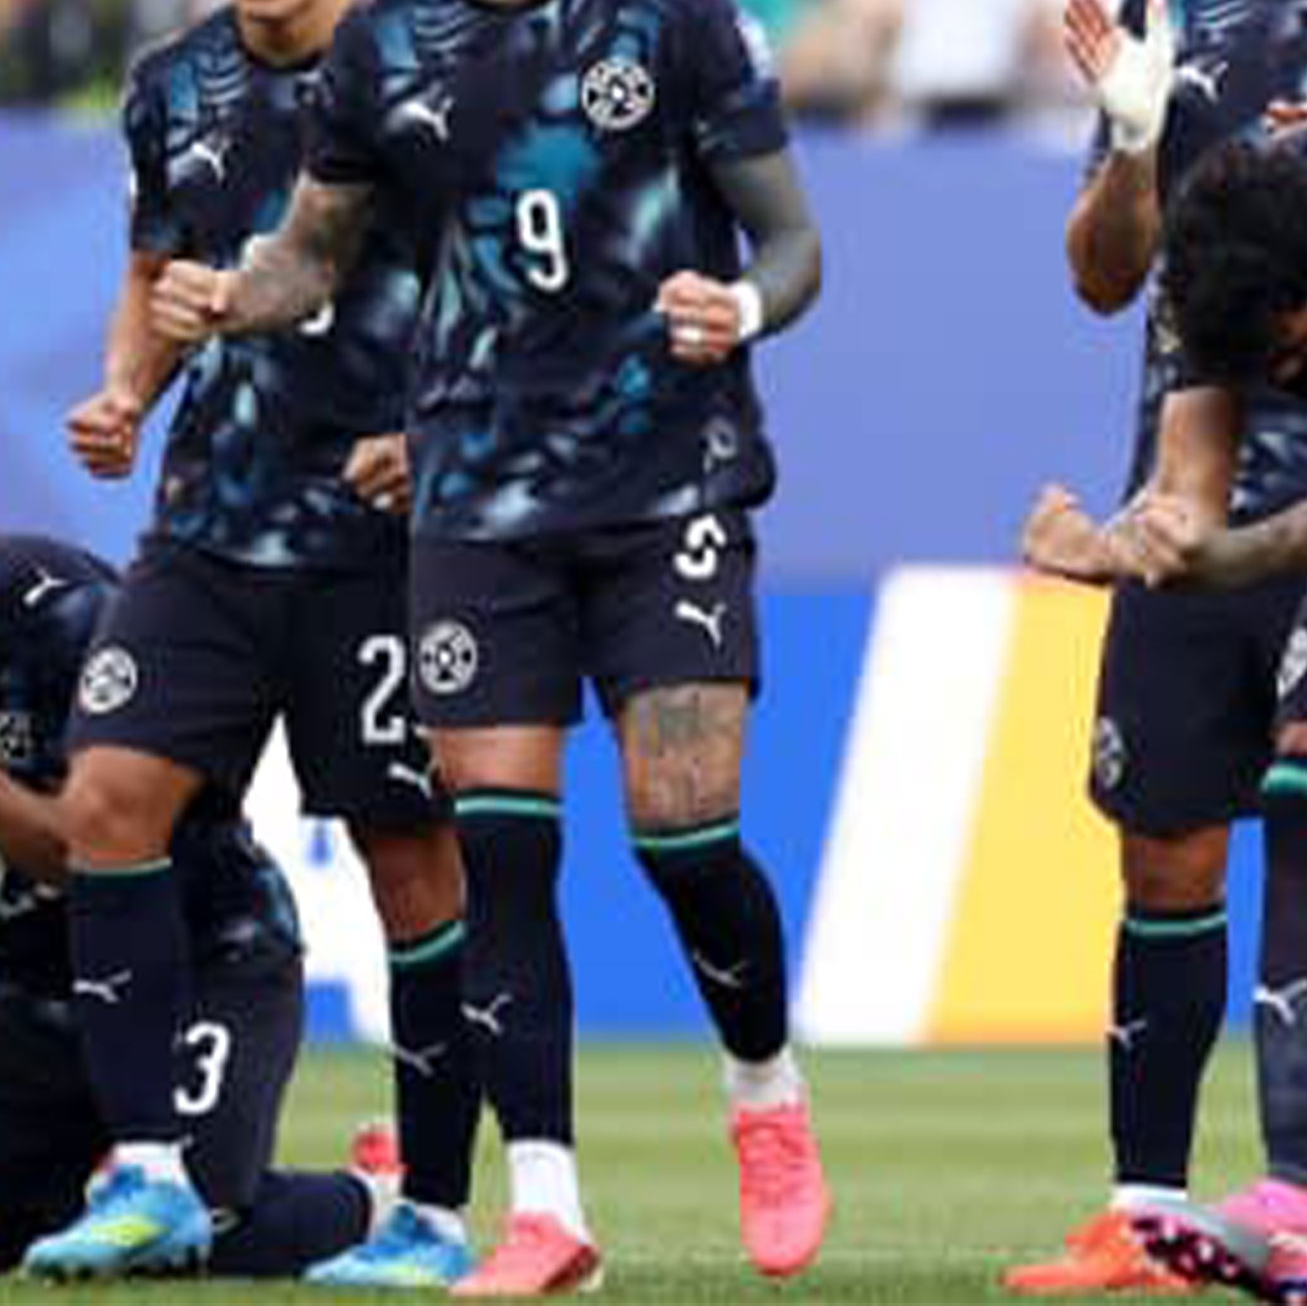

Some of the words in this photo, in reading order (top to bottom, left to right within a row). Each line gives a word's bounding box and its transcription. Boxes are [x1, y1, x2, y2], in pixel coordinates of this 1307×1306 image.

[516, 188, 568, 292] 9
[358, 634, 406, 744] 2
[172, 1020, 231, 1114] 3
